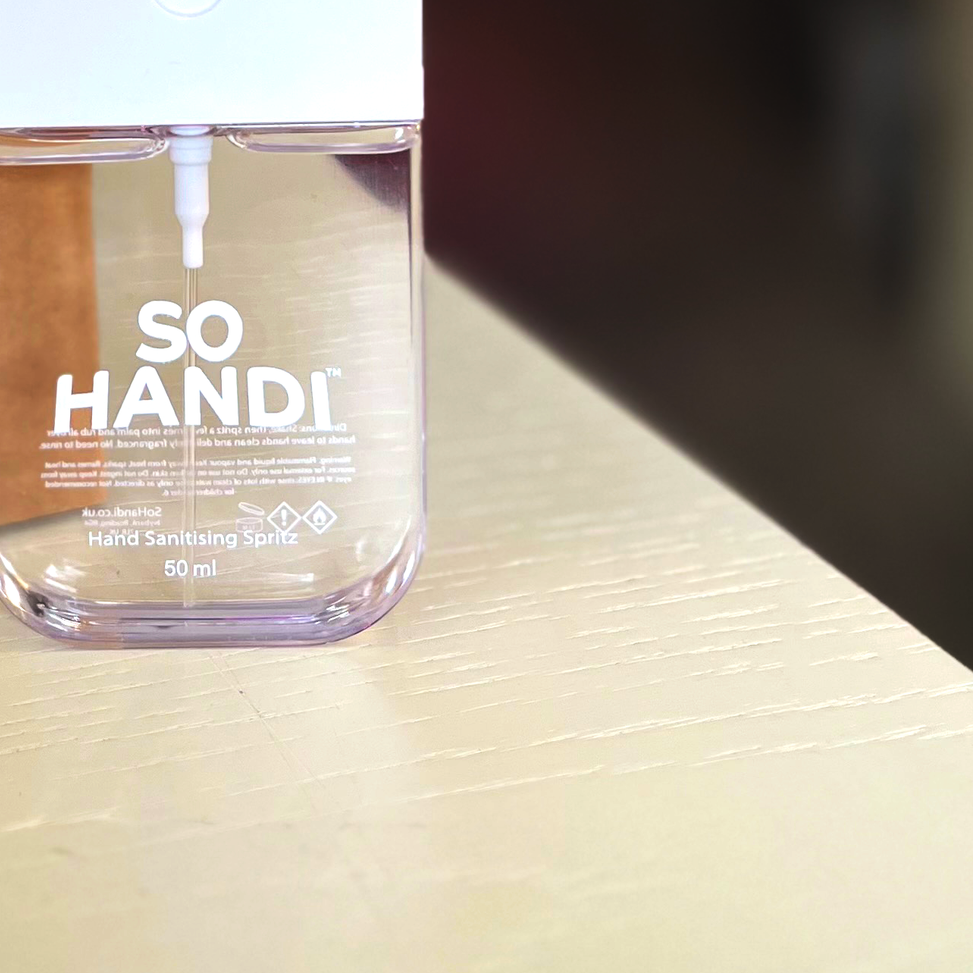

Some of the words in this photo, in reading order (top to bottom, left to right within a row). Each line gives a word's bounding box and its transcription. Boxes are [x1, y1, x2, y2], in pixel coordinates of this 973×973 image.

[135, 300, 244, 363] SO
[53, 366, 332, 434] HANDI
[87, 531, 139, 547] Hand
[144, 530, 238, 549] Sanitising
[243, 530, 299, 548] Spritz
[164, 559, 188, 576] 50
[193, 559, 217, 576] ml
